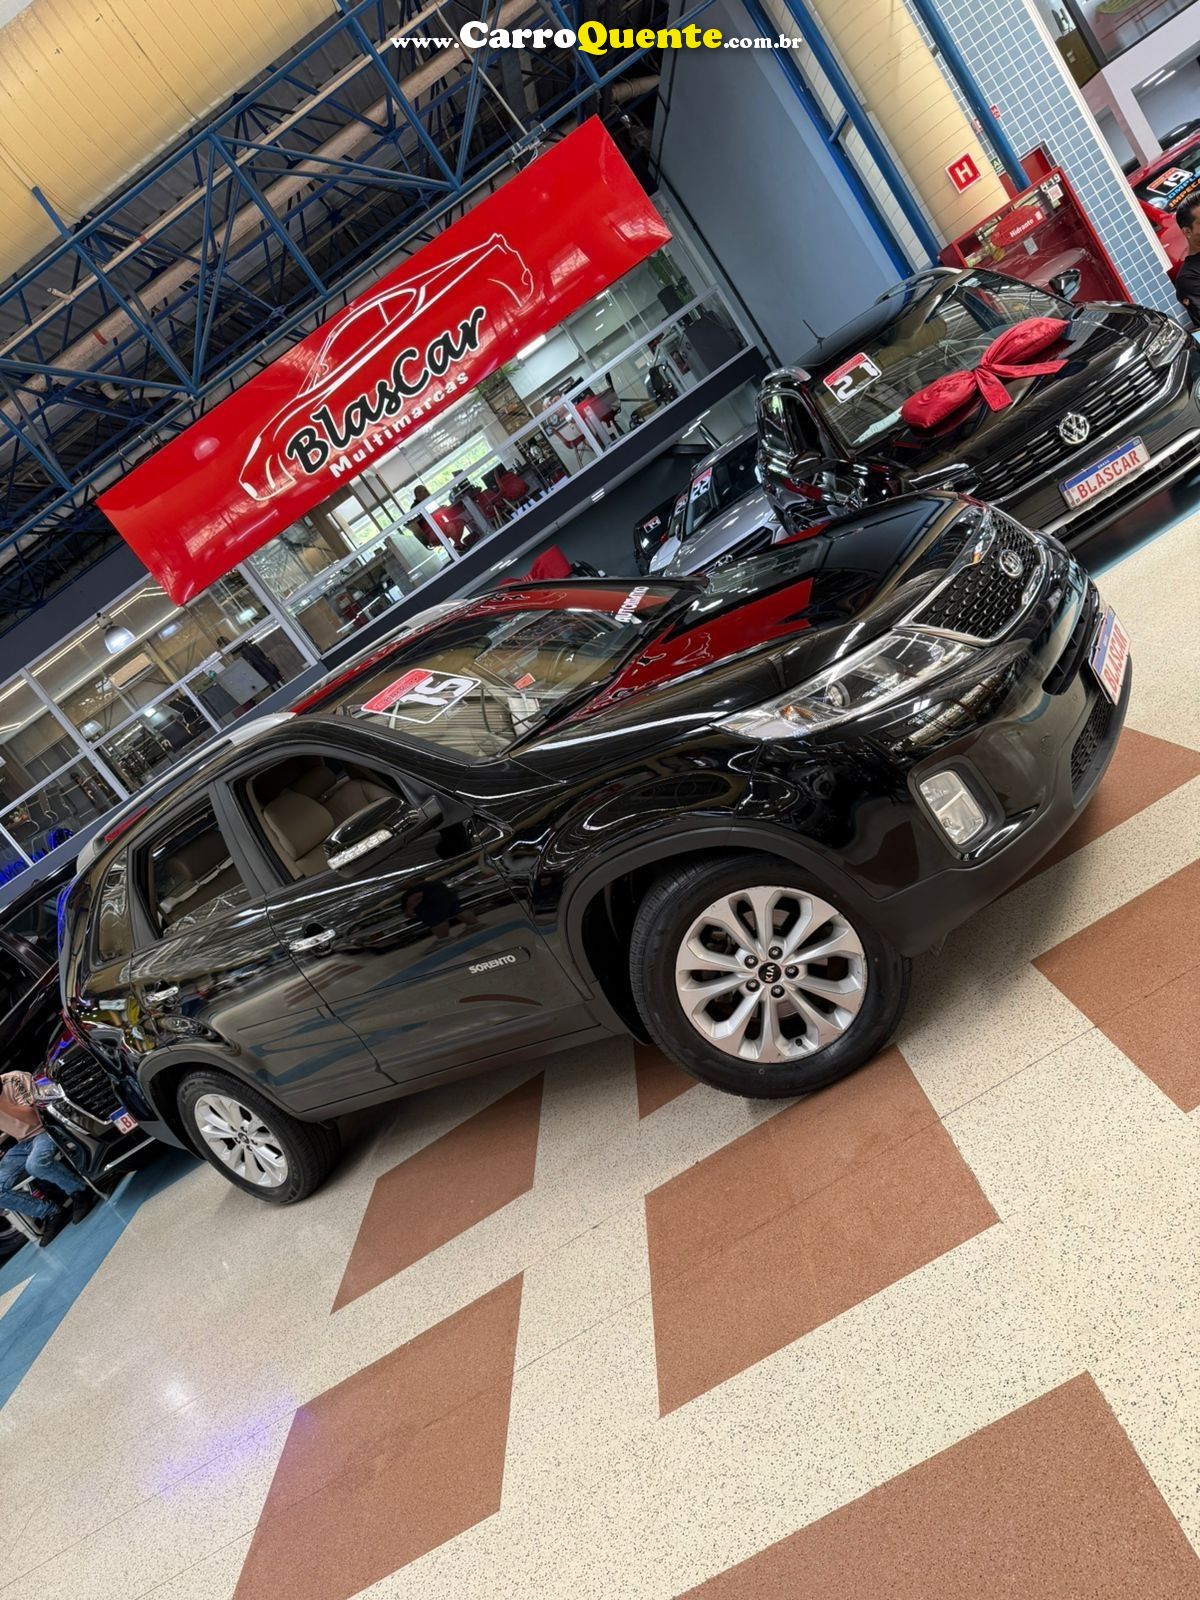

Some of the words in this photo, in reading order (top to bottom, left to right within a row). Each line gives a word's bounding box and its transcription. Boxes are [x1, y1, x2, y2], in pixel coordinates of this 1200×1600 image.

[955, 162, 974, 183] H
[1009, 219, 1034, 238] Hidrante
[286, 306, 486, 474] BlasCar
[328, 373, 469, 479] Multimarcas
[1077, 450, 1140, 499] BLASCAR
[1104, 624, 1128, 695] BLASCAR
[400, 677, 474, 706] 15
[469, 955, 516, 974] SORENTO
[765, 965, 775, 982] KIA
